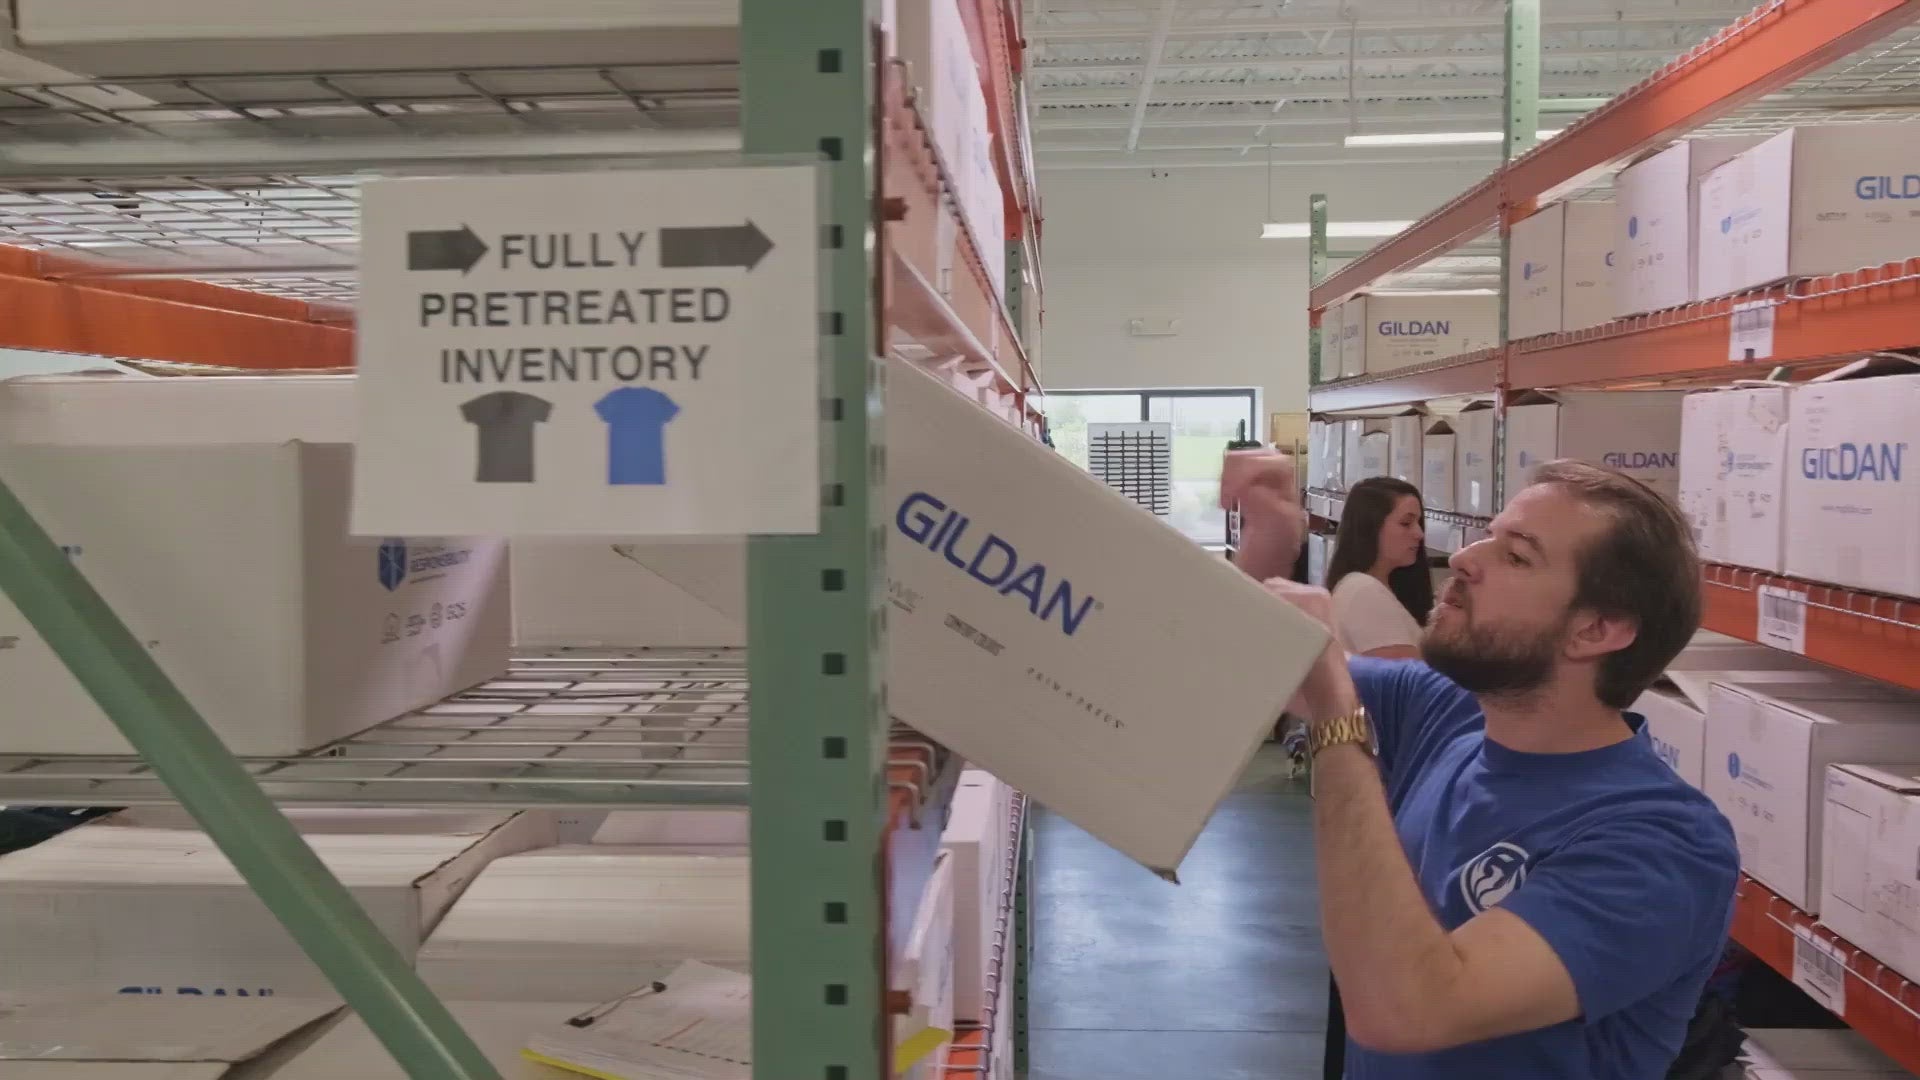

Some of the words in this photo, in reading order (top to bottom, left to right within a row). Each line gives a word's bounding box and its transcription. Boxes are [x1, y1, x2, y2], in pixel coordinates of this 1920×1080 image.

[501, 232, 645, 269] FULLY
[420, 287, 730, 327] PRETREATED
[1379, 321, 1450, 336] GILDAN
[441, 345, 710, 383] INVENTORY
[1603, 452, 1678, 469] GILDAN
[1802, 442, 1902, 482] GILDAN
[896, 491, 1097, 637] GILDAN
